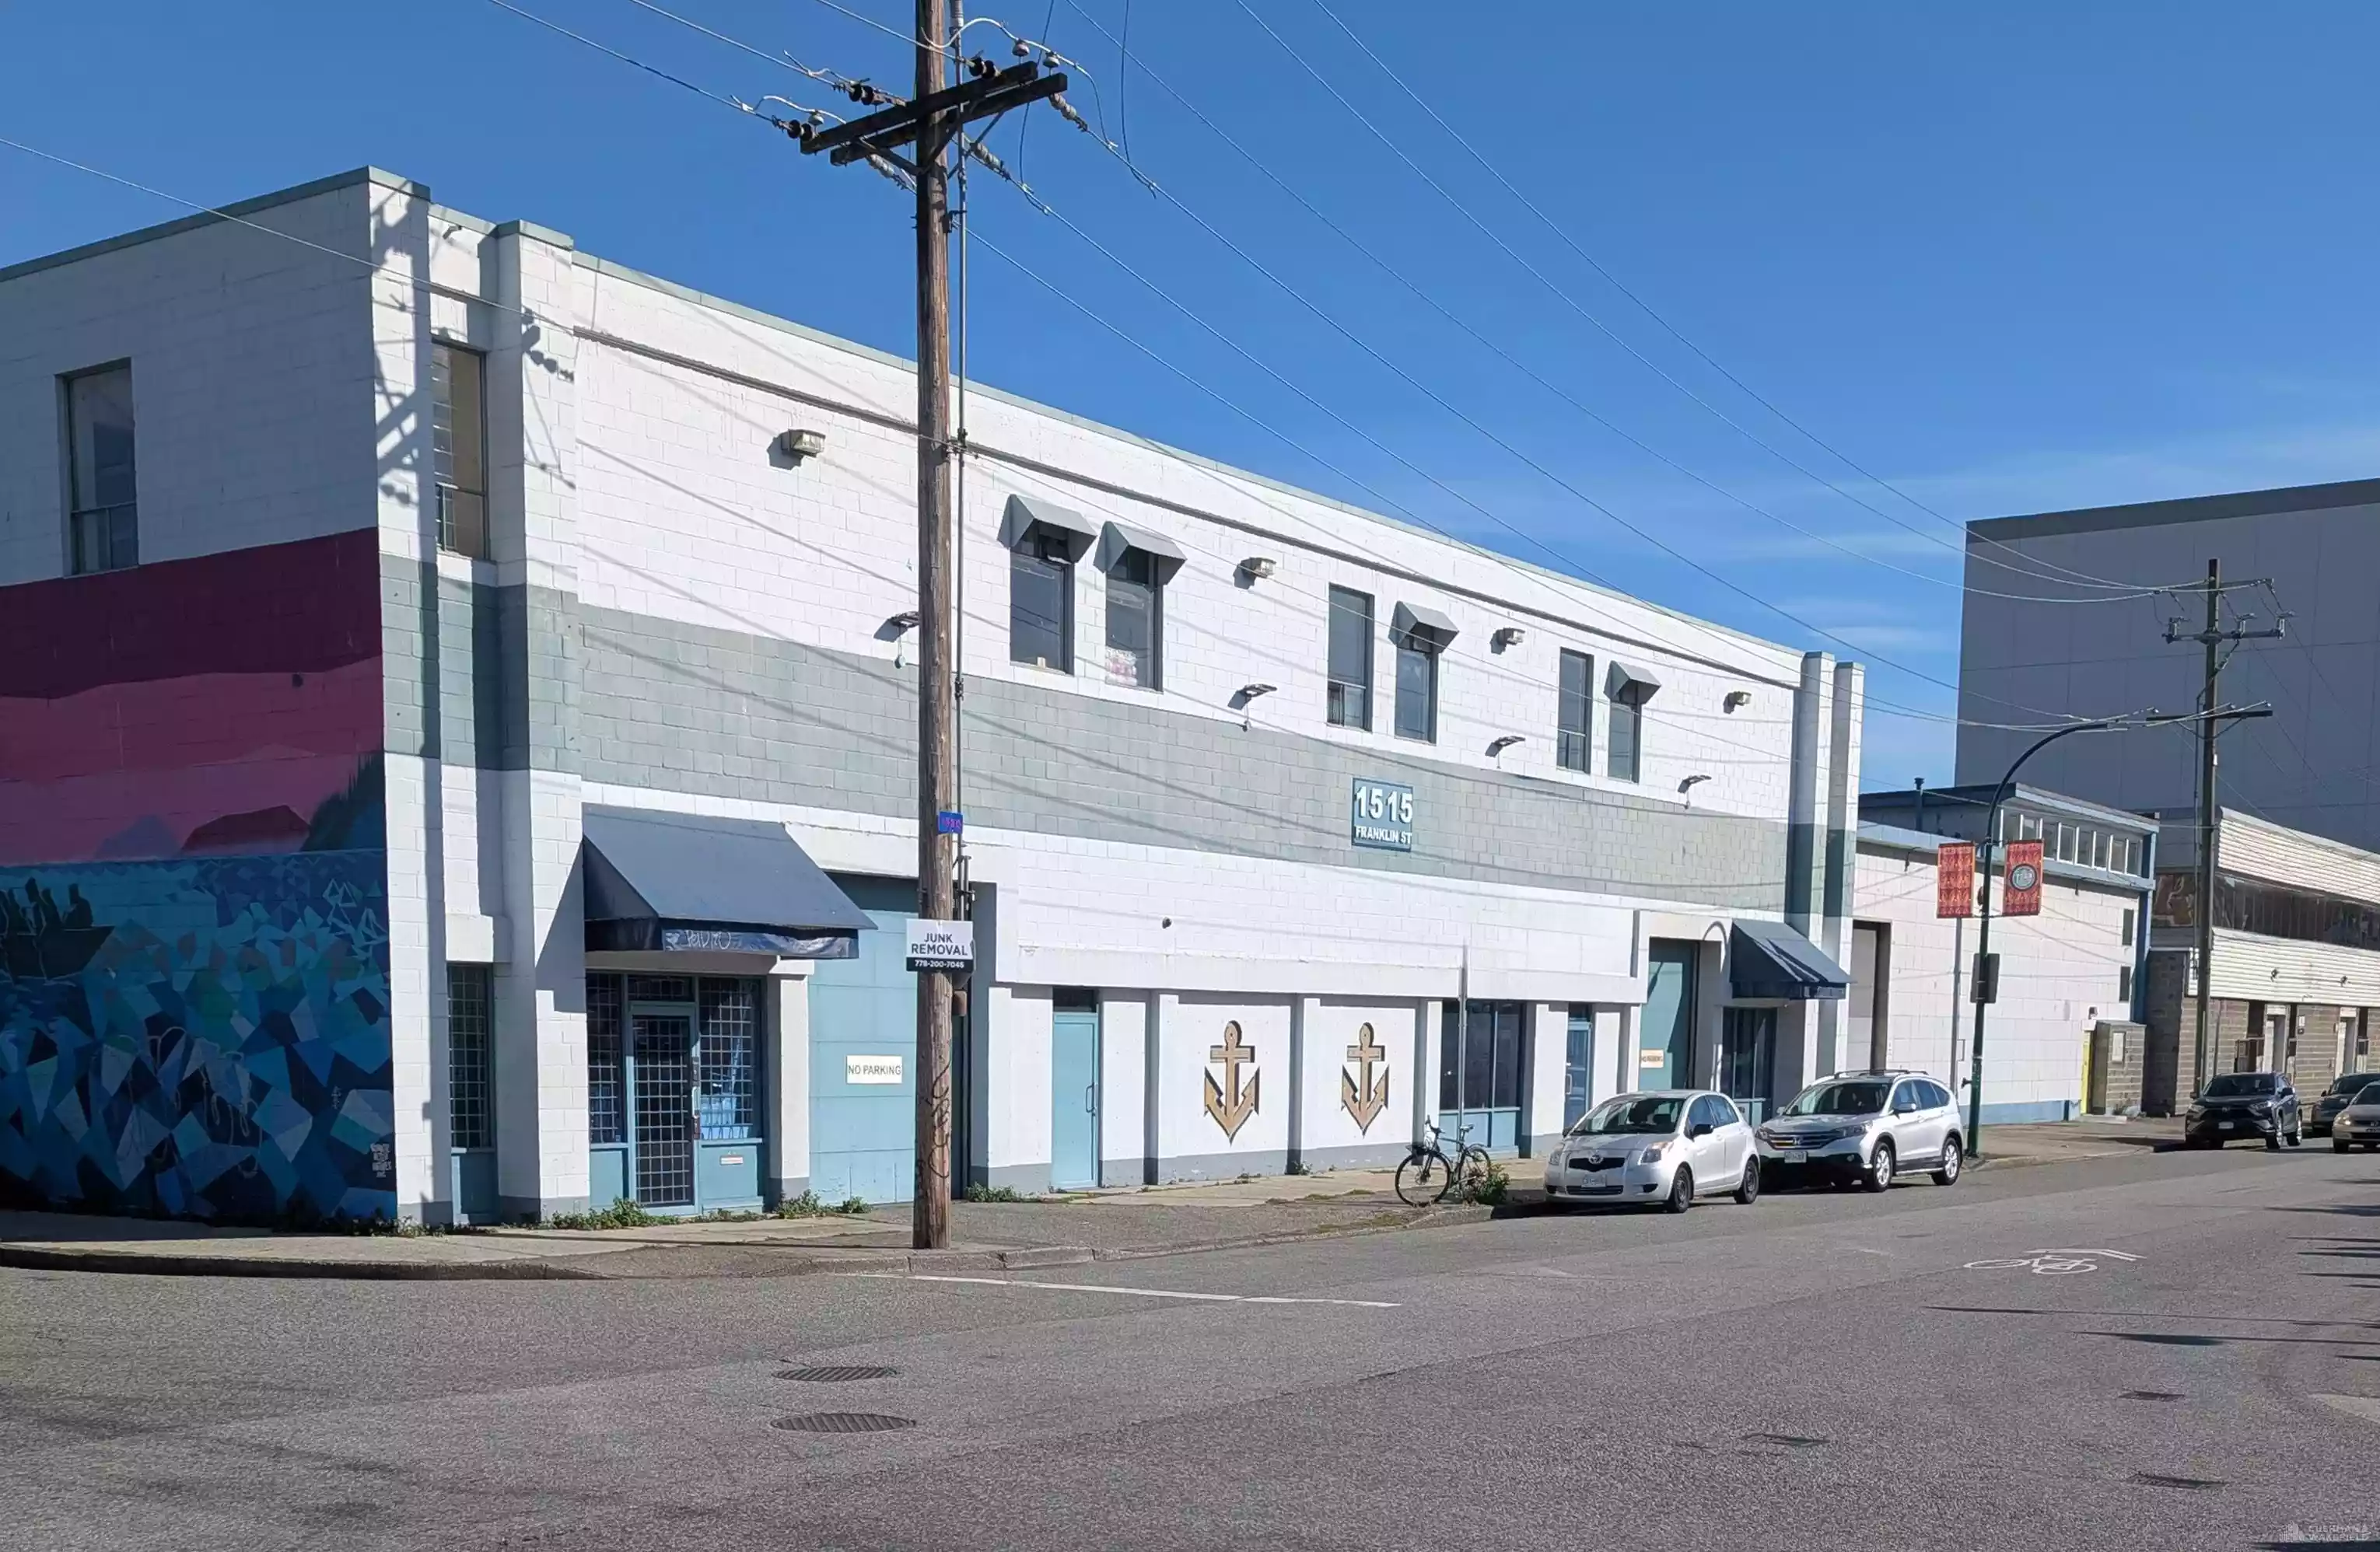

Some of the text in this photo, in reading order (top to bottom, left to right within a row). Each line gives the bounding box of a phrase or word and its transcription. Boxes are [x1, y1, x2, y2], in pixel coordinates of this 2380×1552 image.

[1355, 786, 1413, 823] 1515
[1356, 826, 1413, 844] FRANKLIN ST
[924, 933, 954, 943] JUNK
[911, 943, 968, 956] REMOVAL
[848, 1064, 902, 1075] NO PARKING
